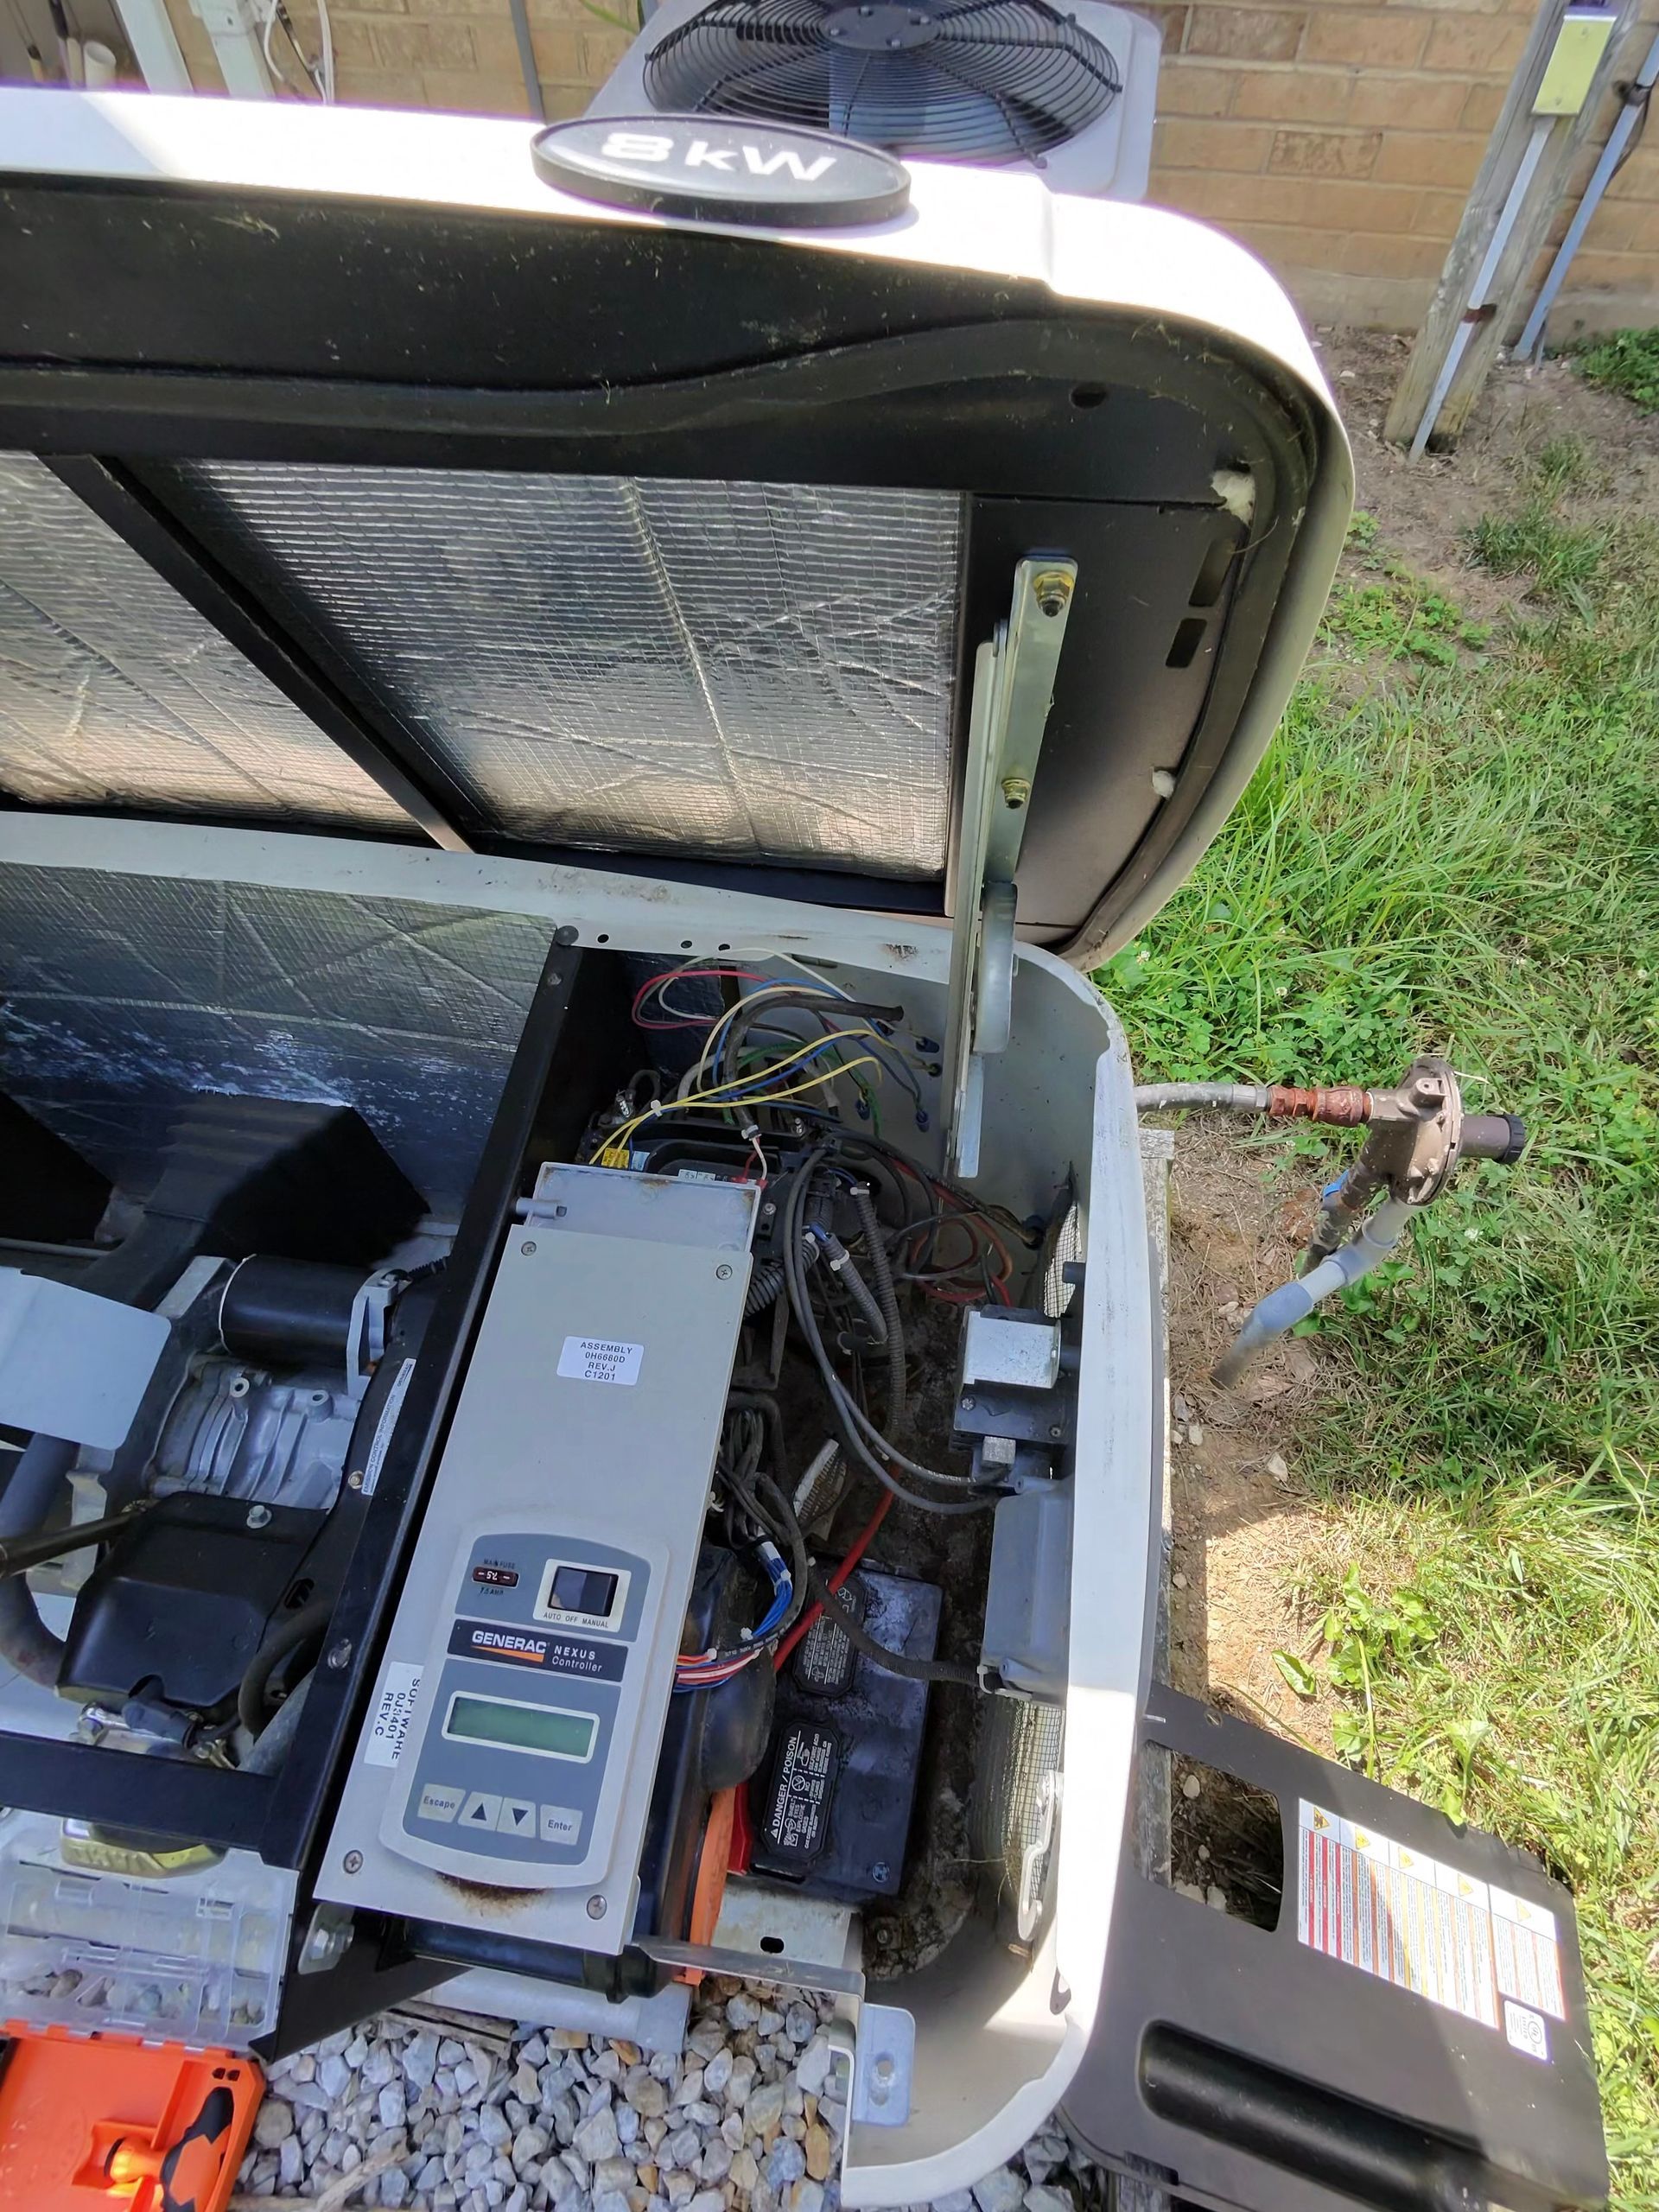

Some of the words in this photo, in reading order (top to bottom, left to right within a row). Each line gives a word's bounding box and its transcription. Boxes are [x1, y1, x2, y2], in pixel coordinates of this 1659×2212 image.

[601, 132, 674, 162] 8
[684, 141, 837, 181] kW
[580, 1342, 632, 1354] ASSEMBLY
[588, 1362, 616, 1372] REV.J
[584, 1370, 615, 1381] C1201
[370, 1434, 382, 1462] CONTROL
[378, 1394, 396, 1433] INFORMATION
[499, 1561, 516, 1570] FUSE
[543, 1611, 562, 1621] AUTO
[565, 1615, 578, 1624] OFF
[582, 1618, 609, 1629] MANUAL
[472, 1630, 548, 1654] GENERAC
[554, 1645, 596, 1660] NEXUS
[551, 1655, 603, 1673] Controller
[375, 1692, 394, 1736] REV.C
[772, 1783, 787, 1827] DANGER
[783, 1736, 797, 1774] POISON
[804, 1782, 810, 1791] NO
[423, 1795, 455, 1809] Escape
[547, 1819, 573, 1833] Enter
